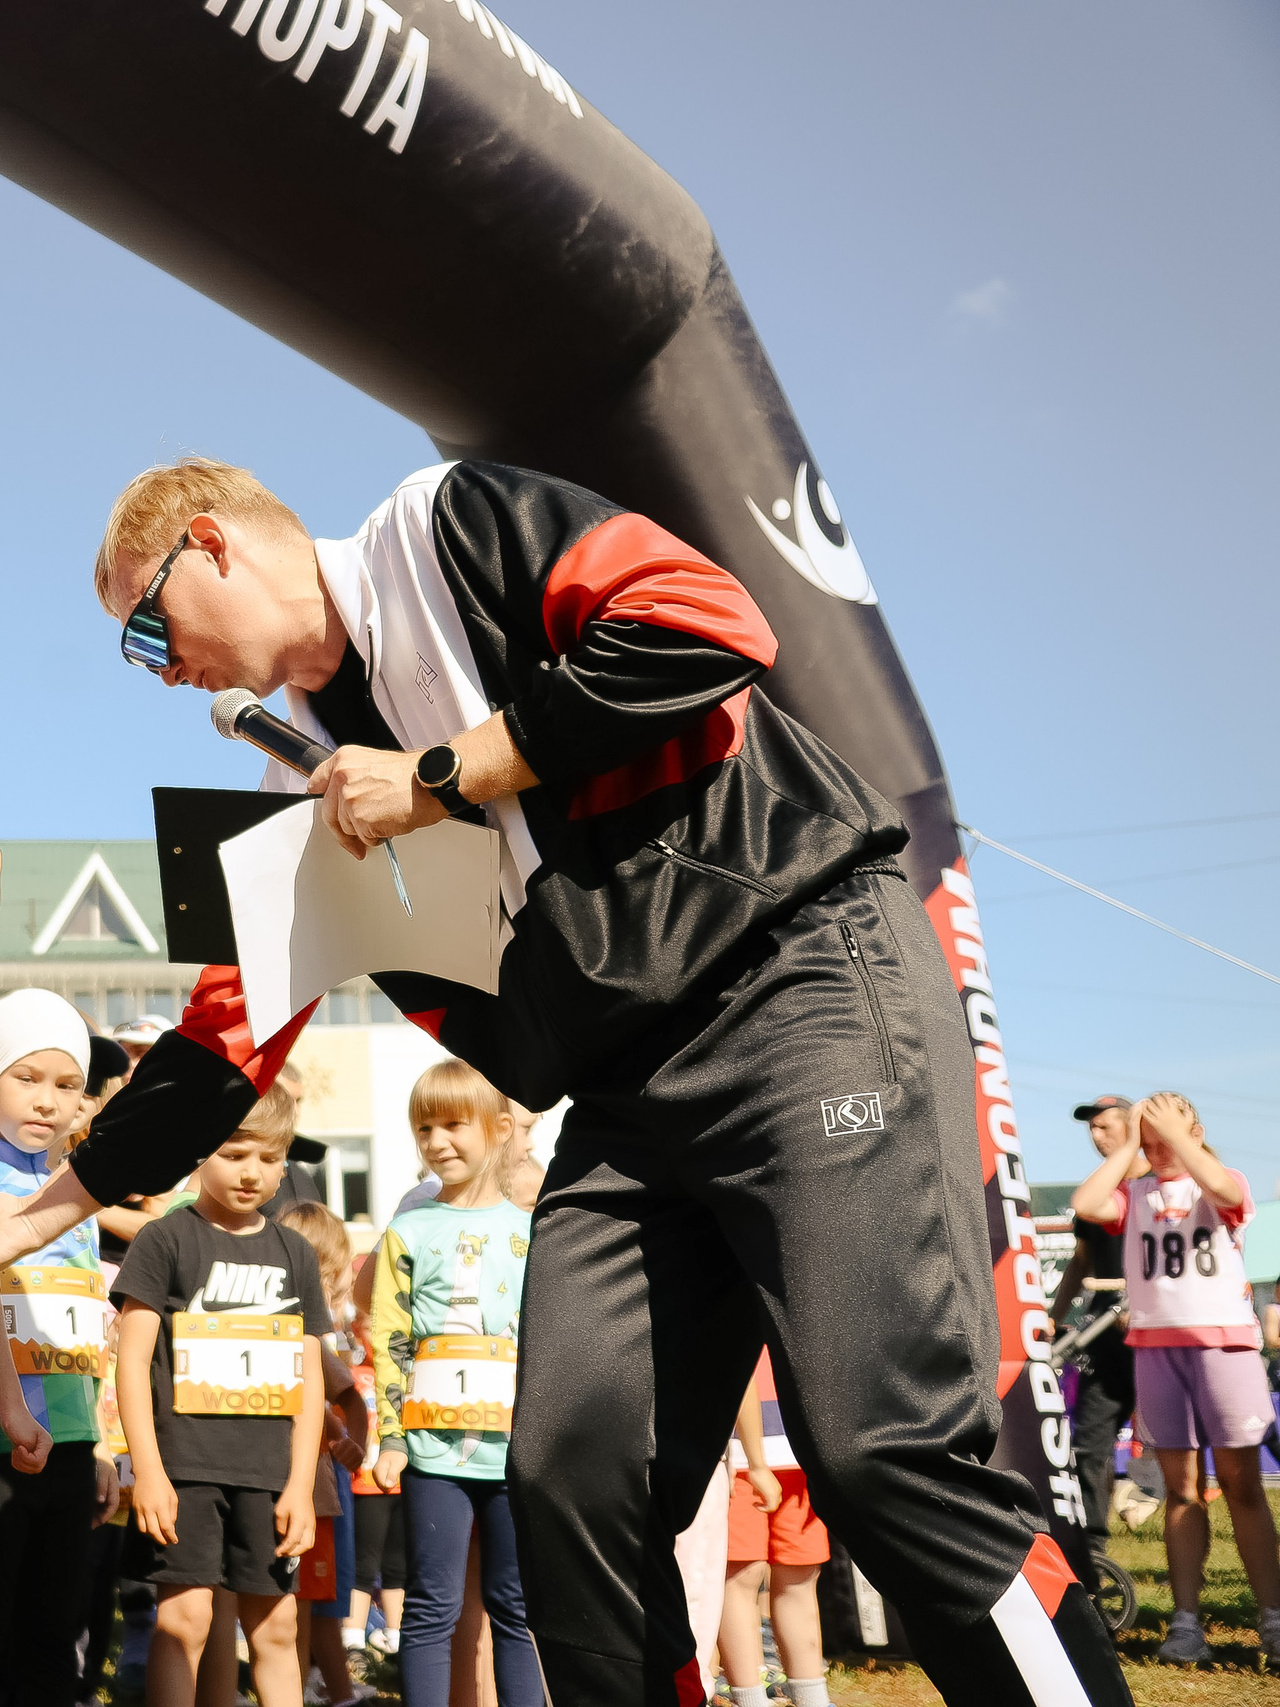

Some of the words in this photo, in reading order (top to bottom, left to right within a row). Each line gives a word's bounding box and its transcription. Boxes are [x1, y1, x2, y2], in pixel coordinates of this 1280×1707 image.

[203, 1260, 287, 1306] NIKE
[66, 1306, 77, 1335] 1
[30, 1350, 101, 1374] WOOD
[240, 1350, 252, 1378] 1
[455, 1369, 466, 1394] 1
[202, 1391, 286, 1411] WOOD
[421, 1408, 502, 1425] WOOD
